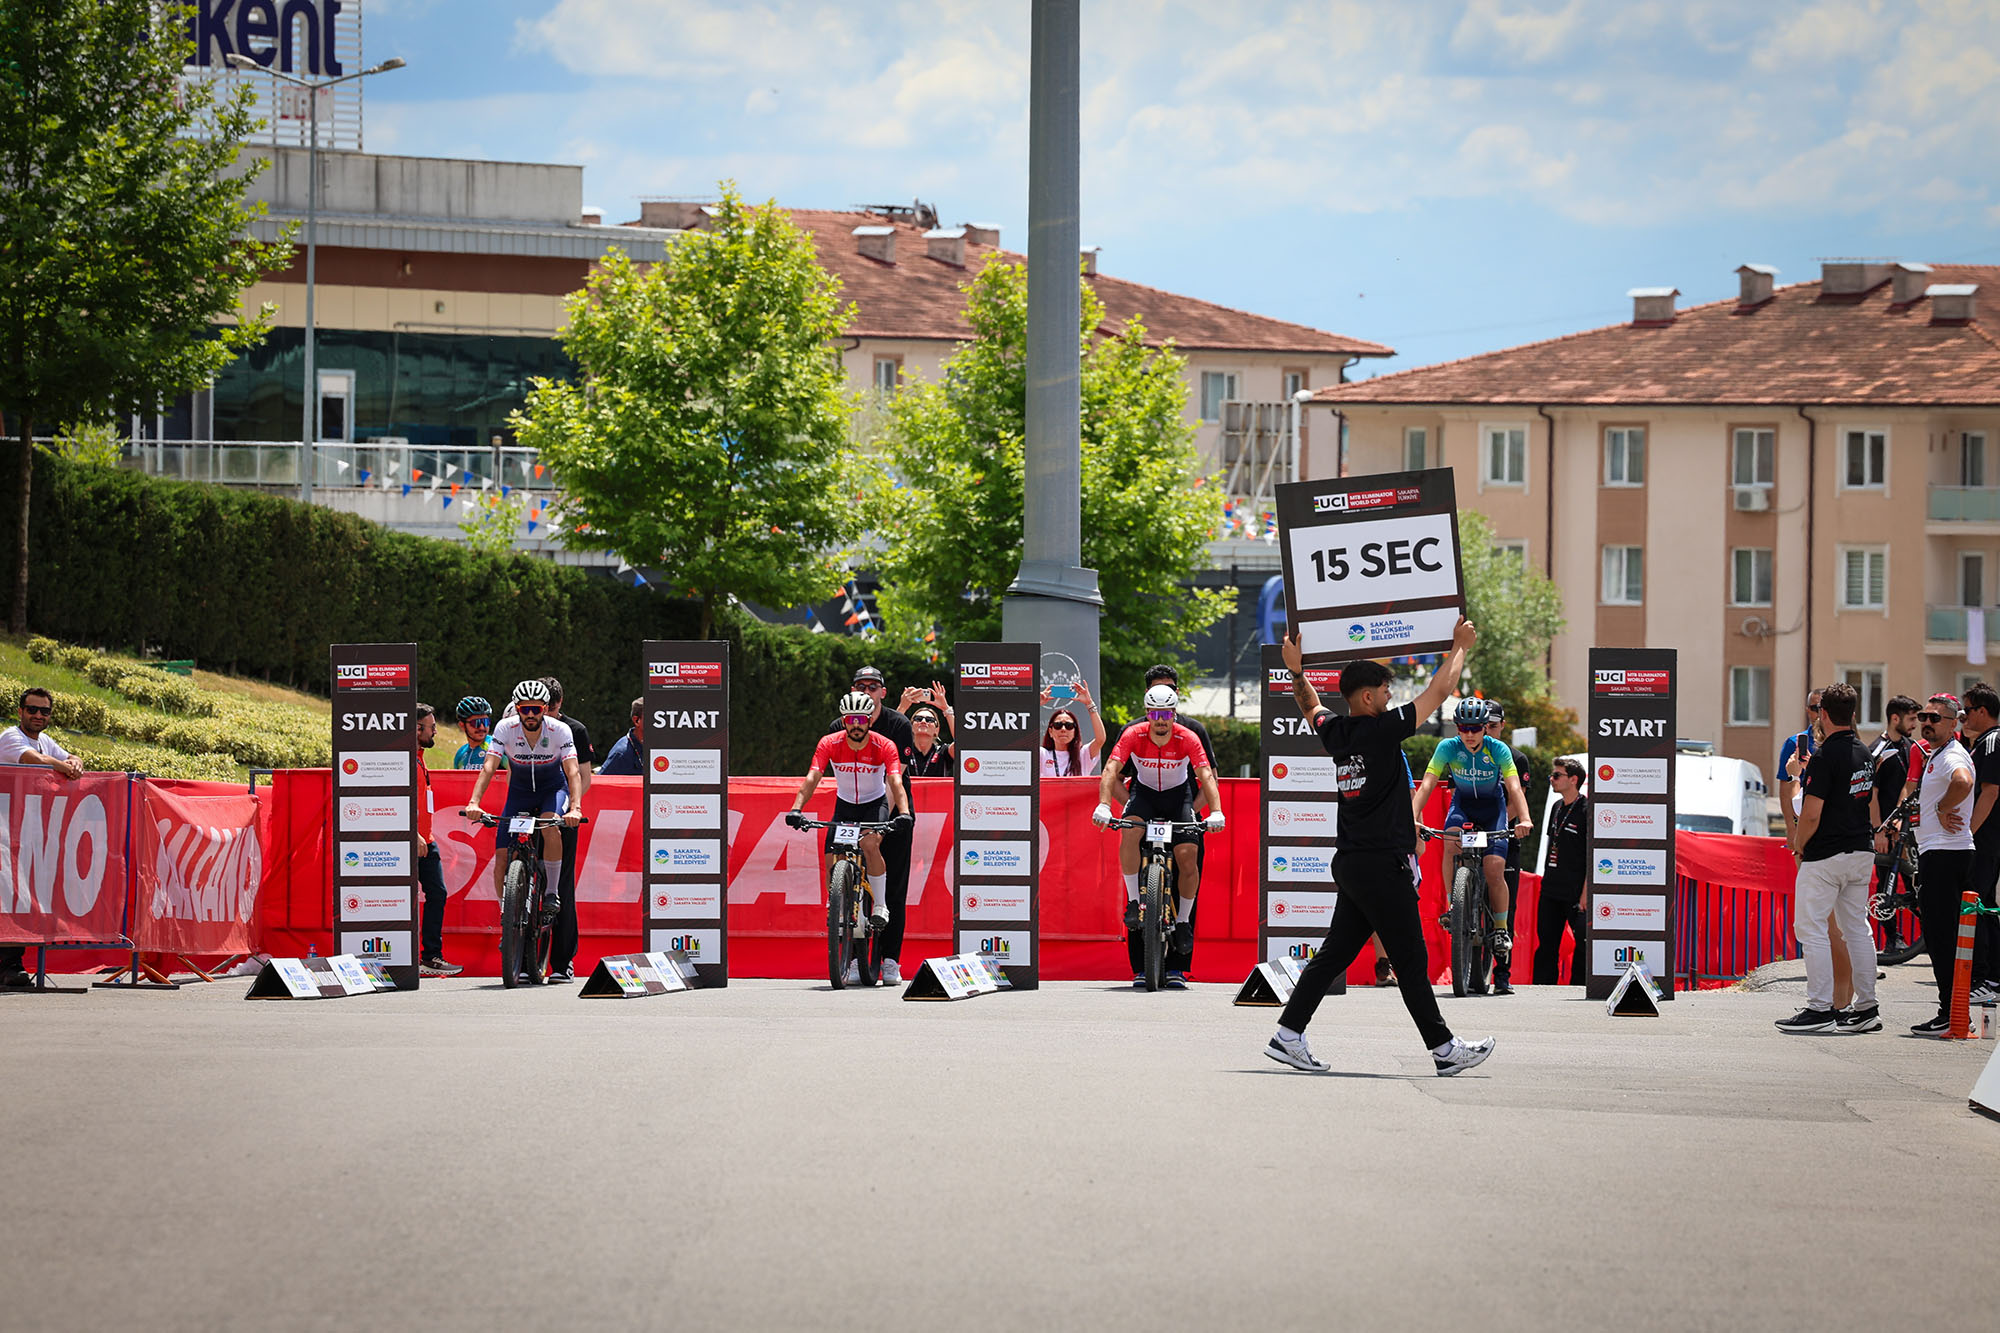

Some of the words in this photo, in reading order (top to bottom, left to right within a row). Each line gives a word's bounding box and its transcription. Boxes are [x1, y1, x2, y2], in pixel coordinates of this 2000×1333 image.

[1320, 496, 1346, 508] UCI
[1310, 548, 1350, 582] 15
[1360, 537, 1443, 578] SEC
[1371, 625, 1414, 634] BÜYÜKŞEHİR
[1372, 632, 1410, 641] BELEDİYESİ
[342, 667, 364, 676] UCI
[655, 665, 676, 674] UCI
[966, 667, 988, 675] UCI
[1274, 672, 1293, 680] UC
[1601, 673, 1623, 681] UCI
[342, 713, 408, 731] START
[653, 710, 719, 728] START
[964, 712, 1030, 730] START
[1272, 718, 1318, 735] STA
[1598, 718, 1666, 737] START
[840, 829, 854, 837] 23
[1153, 828, 1165, 836] 10
[152, 818, 262, 924] SALCANO
[362, 937, 391, 952] CITY
[672, 935, 700, 950] CITY
[981, 936, 1010, 952] CITY
[1614, 946, 1644, 961] CITY
